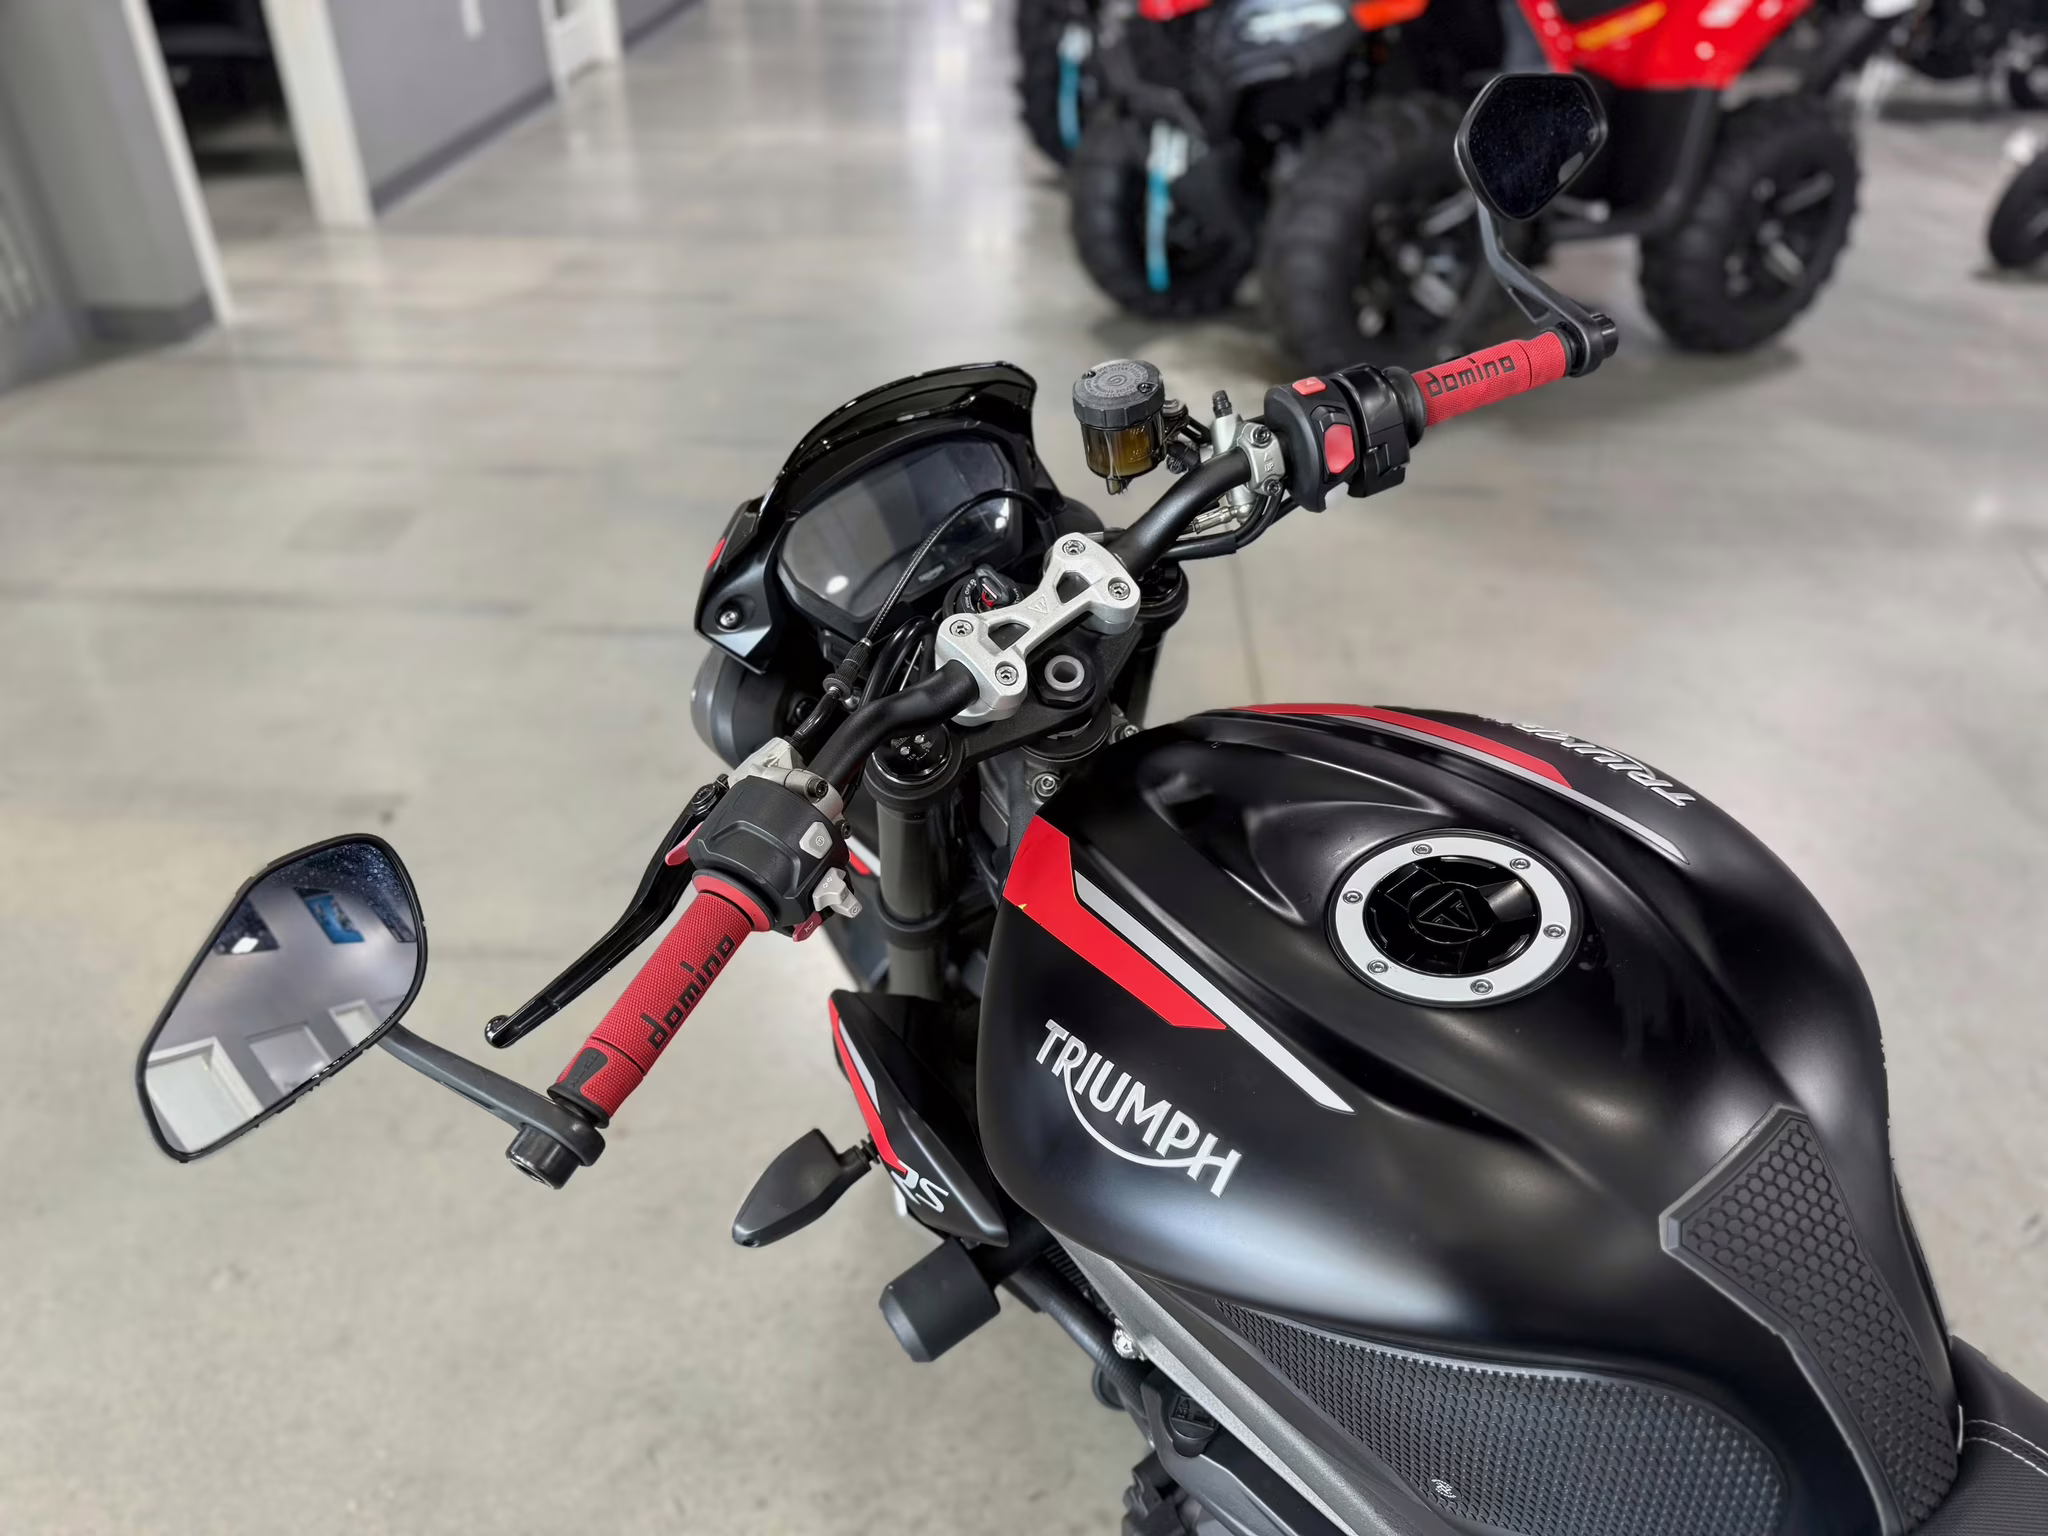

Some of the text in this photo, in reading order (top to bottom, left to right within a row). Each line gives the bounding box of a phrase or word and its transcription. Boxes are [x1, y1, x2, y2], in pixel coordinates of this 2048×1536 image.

[1425, 356, 1516, 397] domino
[1500, 721, 1696, 807] TRIUM
[641, 935, 736, 1050] domino
[1035, 1018, 1243, 1199] TRIUMPH
